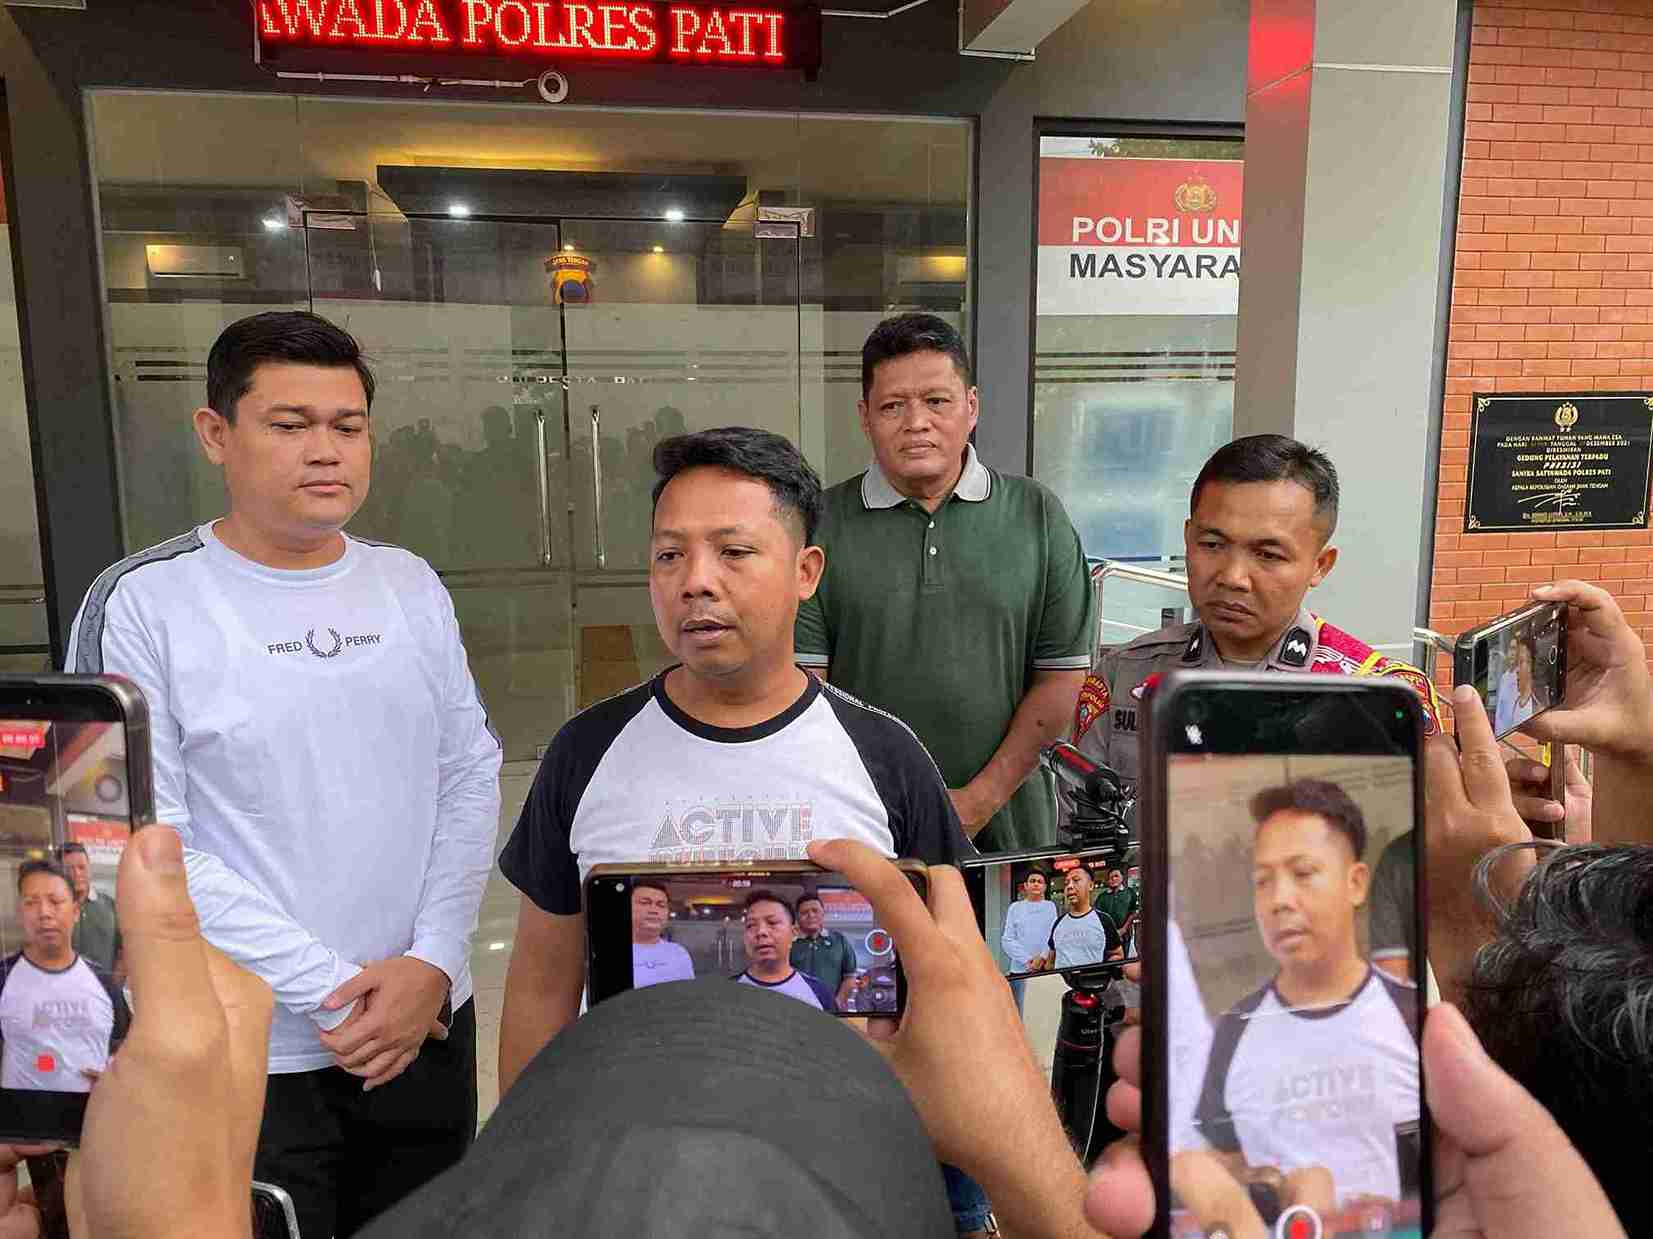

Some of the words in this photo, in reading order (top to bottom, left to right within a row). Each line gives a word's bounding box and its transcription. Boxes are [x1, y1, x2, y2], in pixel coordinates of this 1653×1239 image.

[462, 0, 657, 50] POLRES
[671, 8, 783, 57] PATI
[1072, 217, 1179, 243] POLRI
[1192, 219, 1240, 244] UN
[1070, 253, 1240, 278] MASYARA
[267, 641, 303, 654] FRED
[345, 634, 381, 647] PERRY
